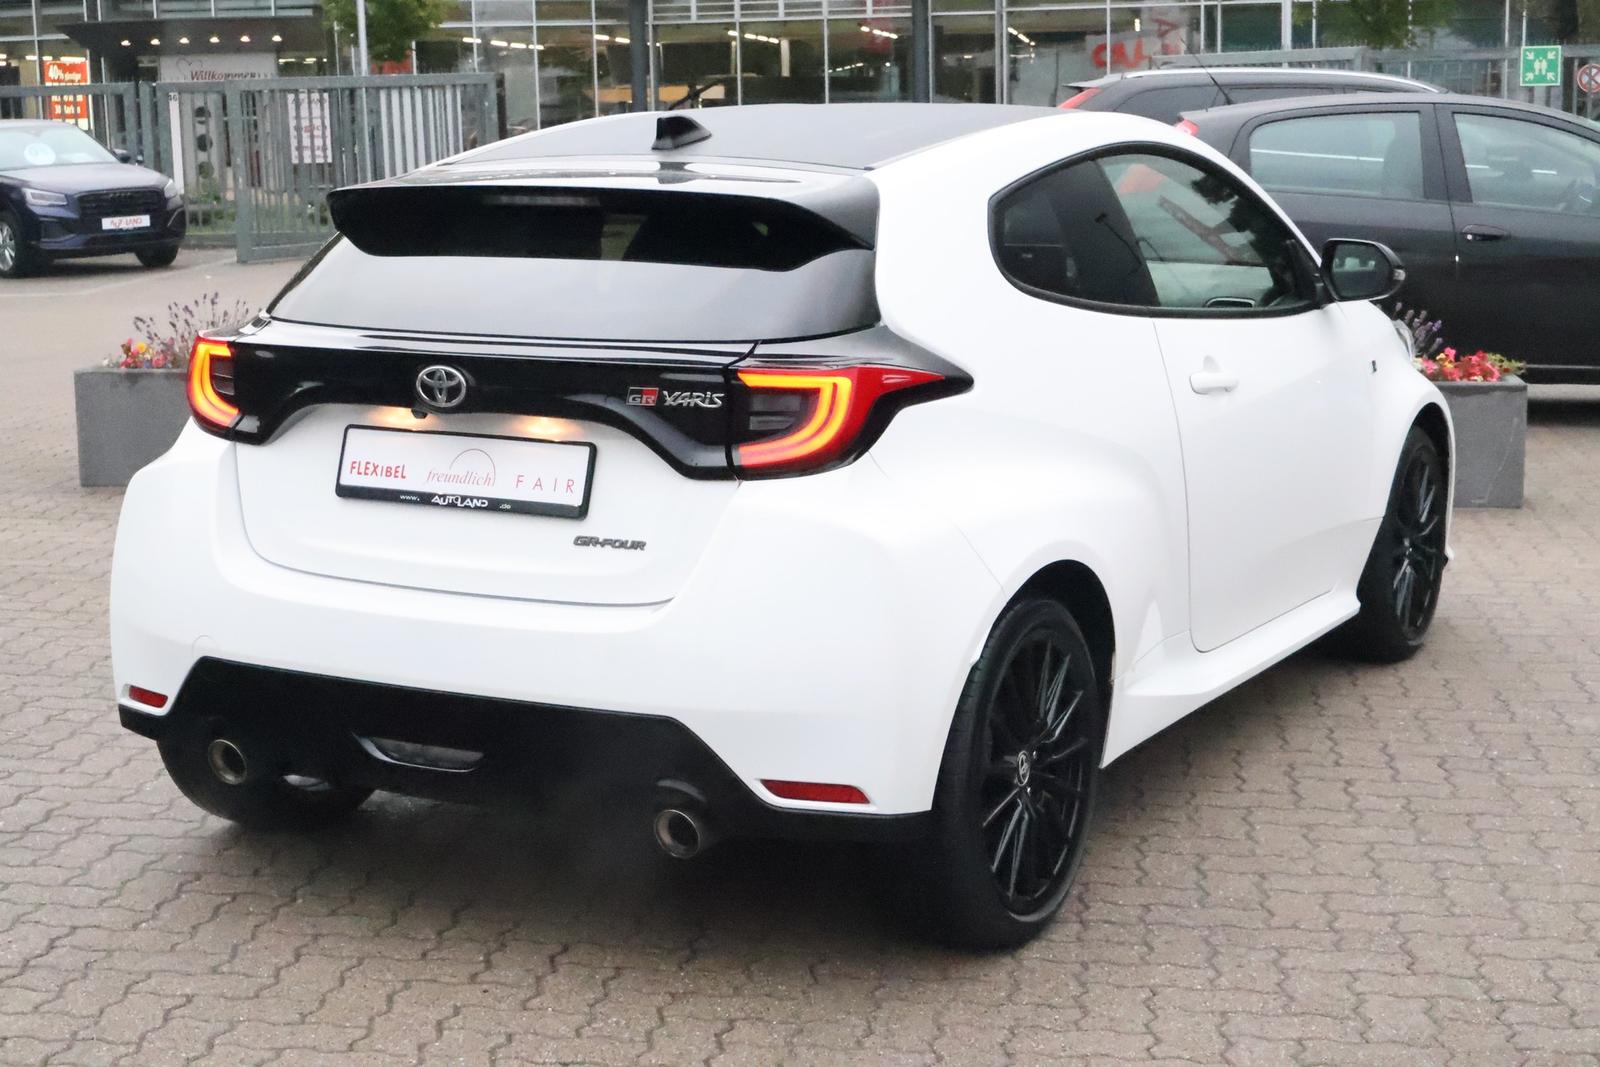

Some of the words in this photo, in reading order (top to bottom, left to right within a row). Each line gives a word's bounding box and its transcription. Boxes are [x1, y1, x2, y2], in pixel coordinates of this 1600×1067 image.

[628, 392, 656, 405] GR
[350, 460, 406, 479] FLEXIBEL
[424, 469, 493, 488] freundlich
[515, 474, 575, 494] FAIR
[431, 495, 489, 509] AUTOLAND
[573, 535, 647, 551] GR-FOUR
